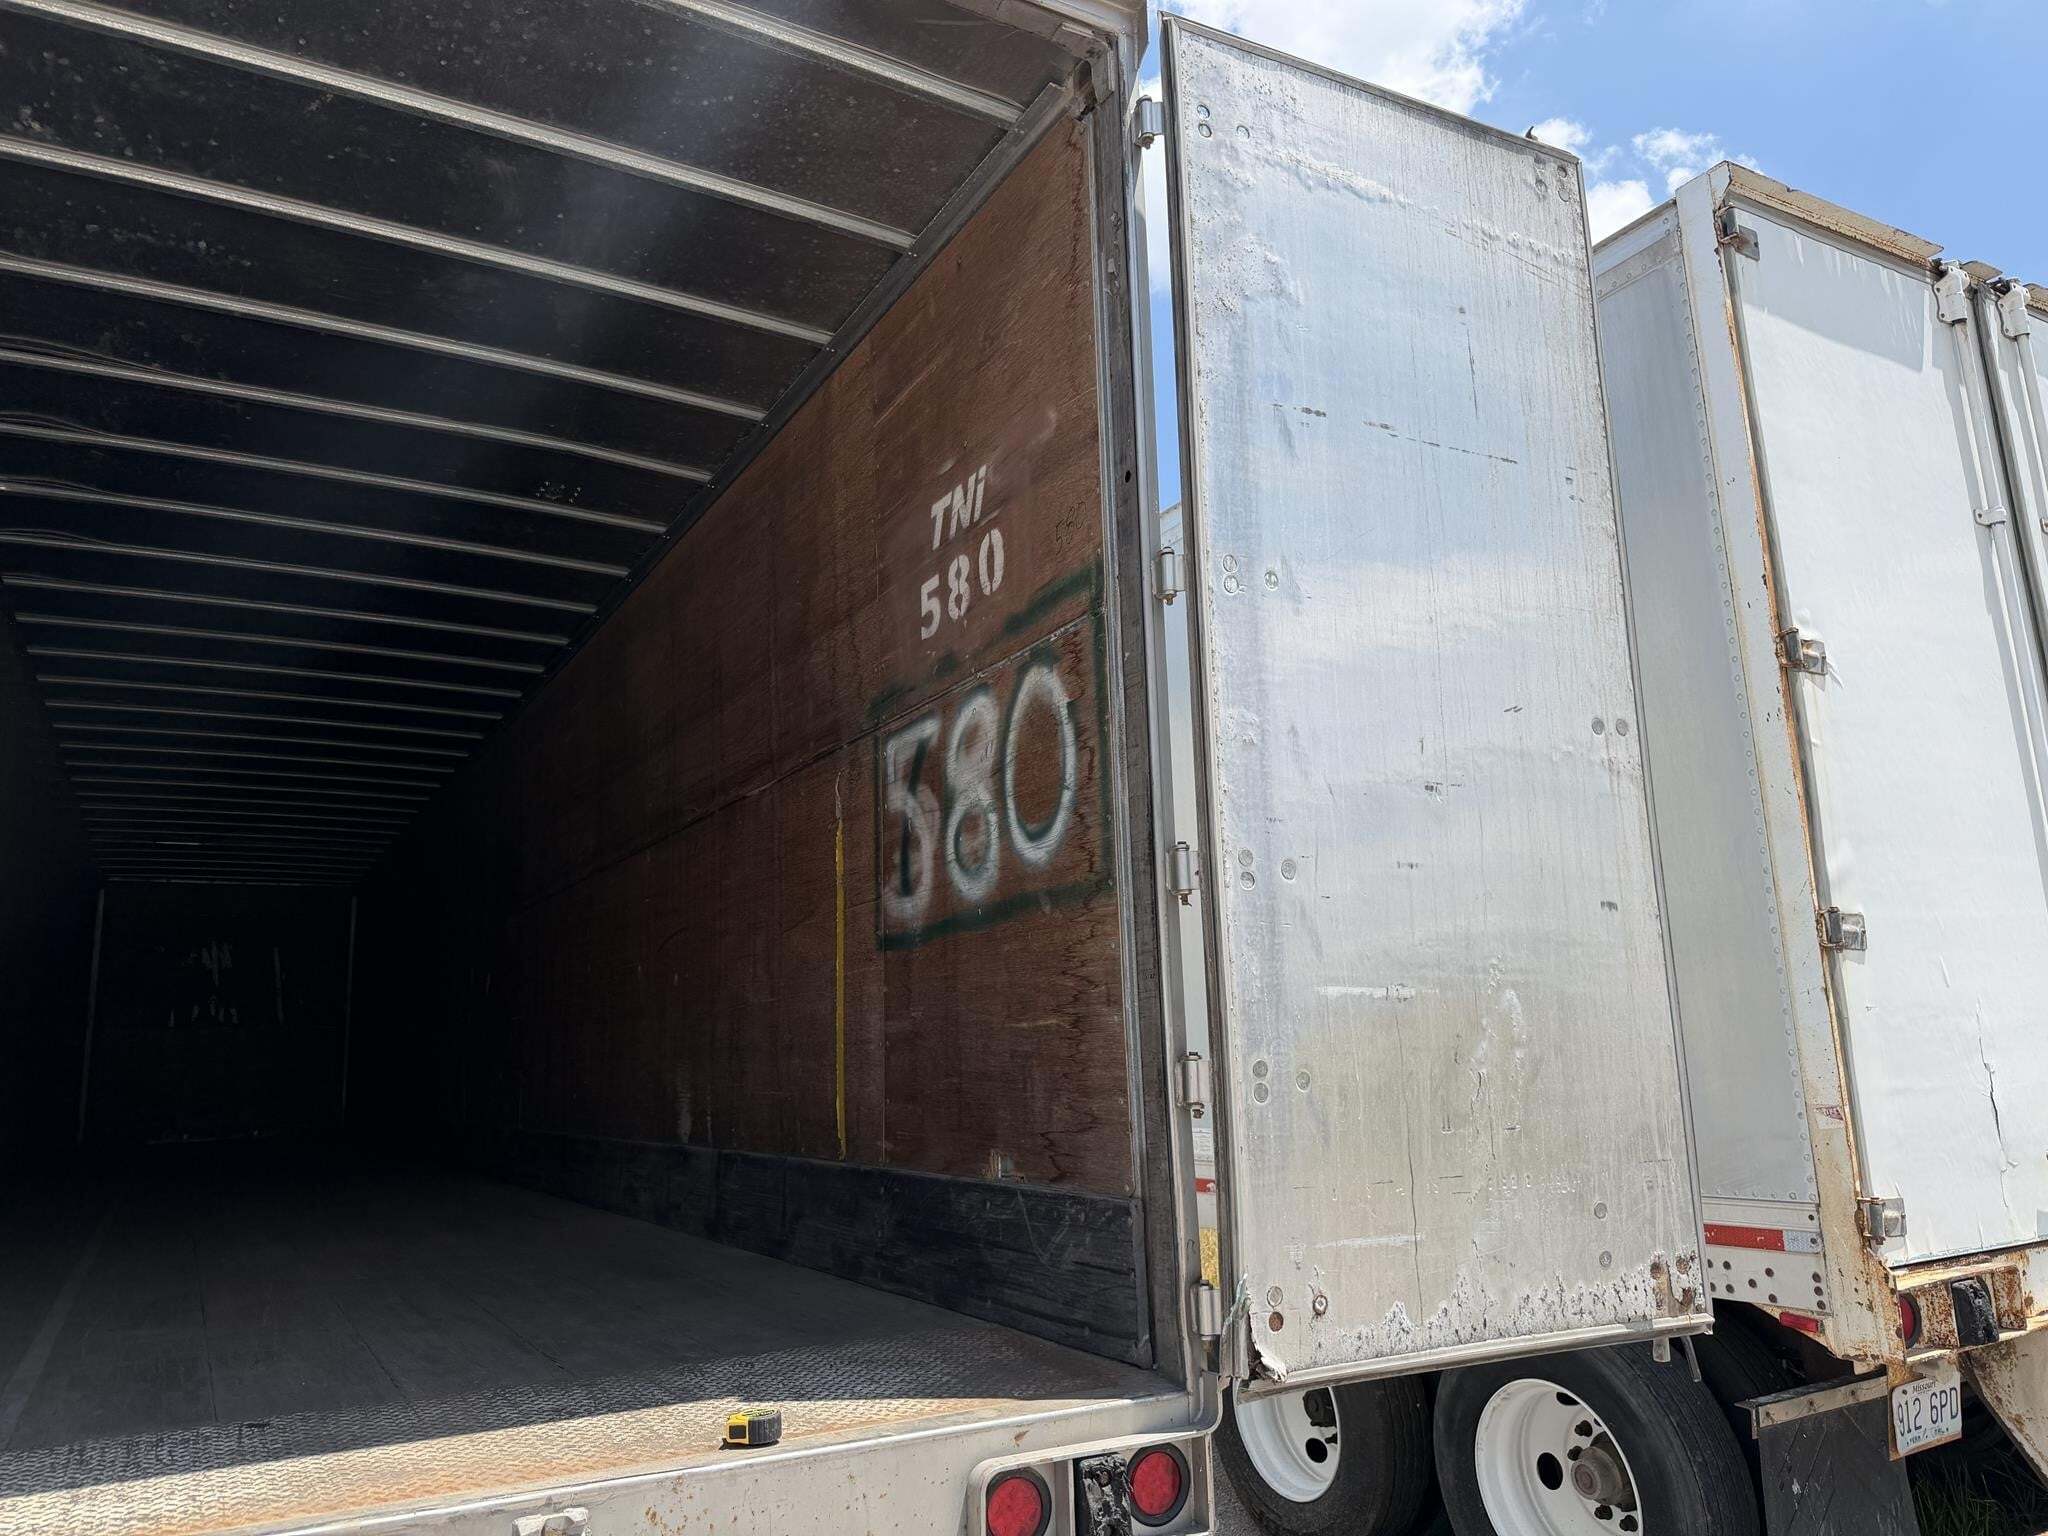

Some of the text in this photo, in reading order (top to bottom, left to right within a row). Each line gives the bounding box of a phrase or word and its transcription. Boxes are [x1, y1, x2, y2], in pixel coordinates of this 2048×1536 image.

[920, 527, 1005, 640] 580
[884, 662, 1077, 922] 580
[1897, 1386, 1959, 1437] 912 6PD
